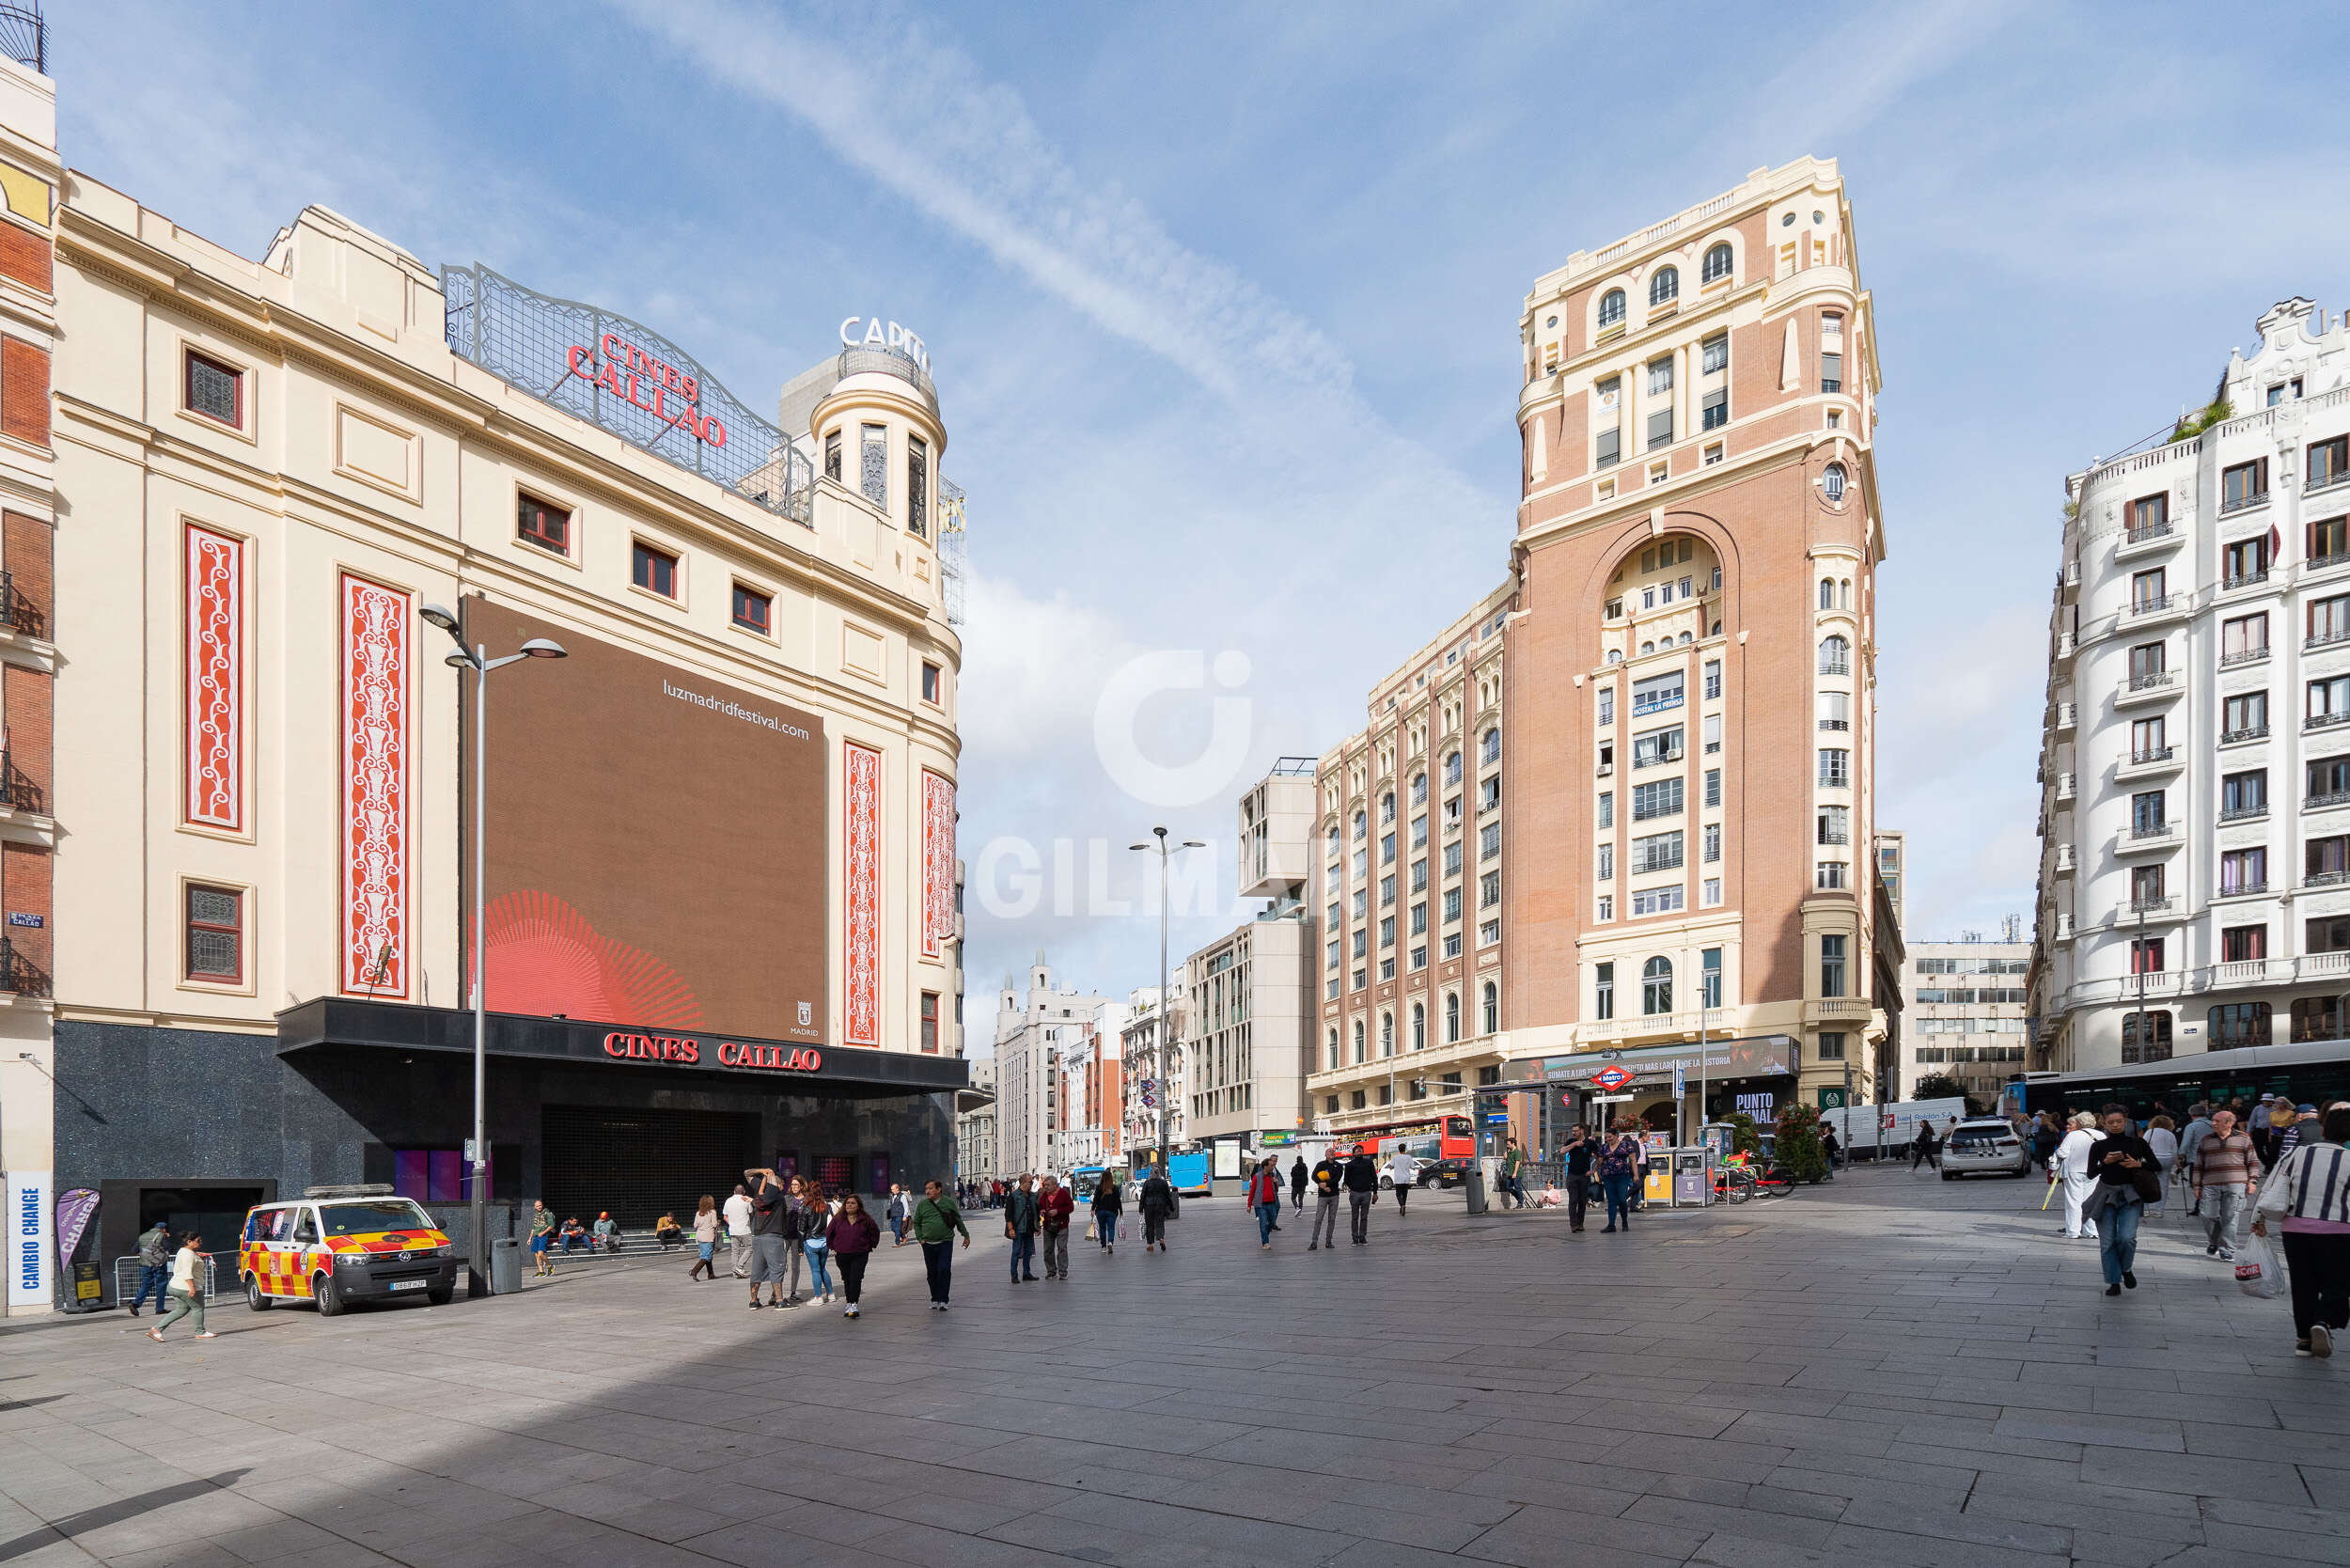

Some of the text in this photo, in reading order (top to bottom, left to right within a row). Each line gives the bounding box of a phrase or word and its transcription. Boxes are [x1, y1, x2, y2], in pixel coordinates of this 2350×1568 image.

[602, 333, 699, 402] CINES
[567, 345, 727, 448] CALLAO
[663, 679, 810, 741] luzmadridfestival.com
[603, 1032, 822, 1072] CINES CALLAO
[790, 1027, 819, 1037] MADRID
[1602, 1074, 1622, 1082] Metro
[1736, 1092, 1774, 1110] PUNTO
[22, 1187, 39, 1290] CAMBIO CHANGE
